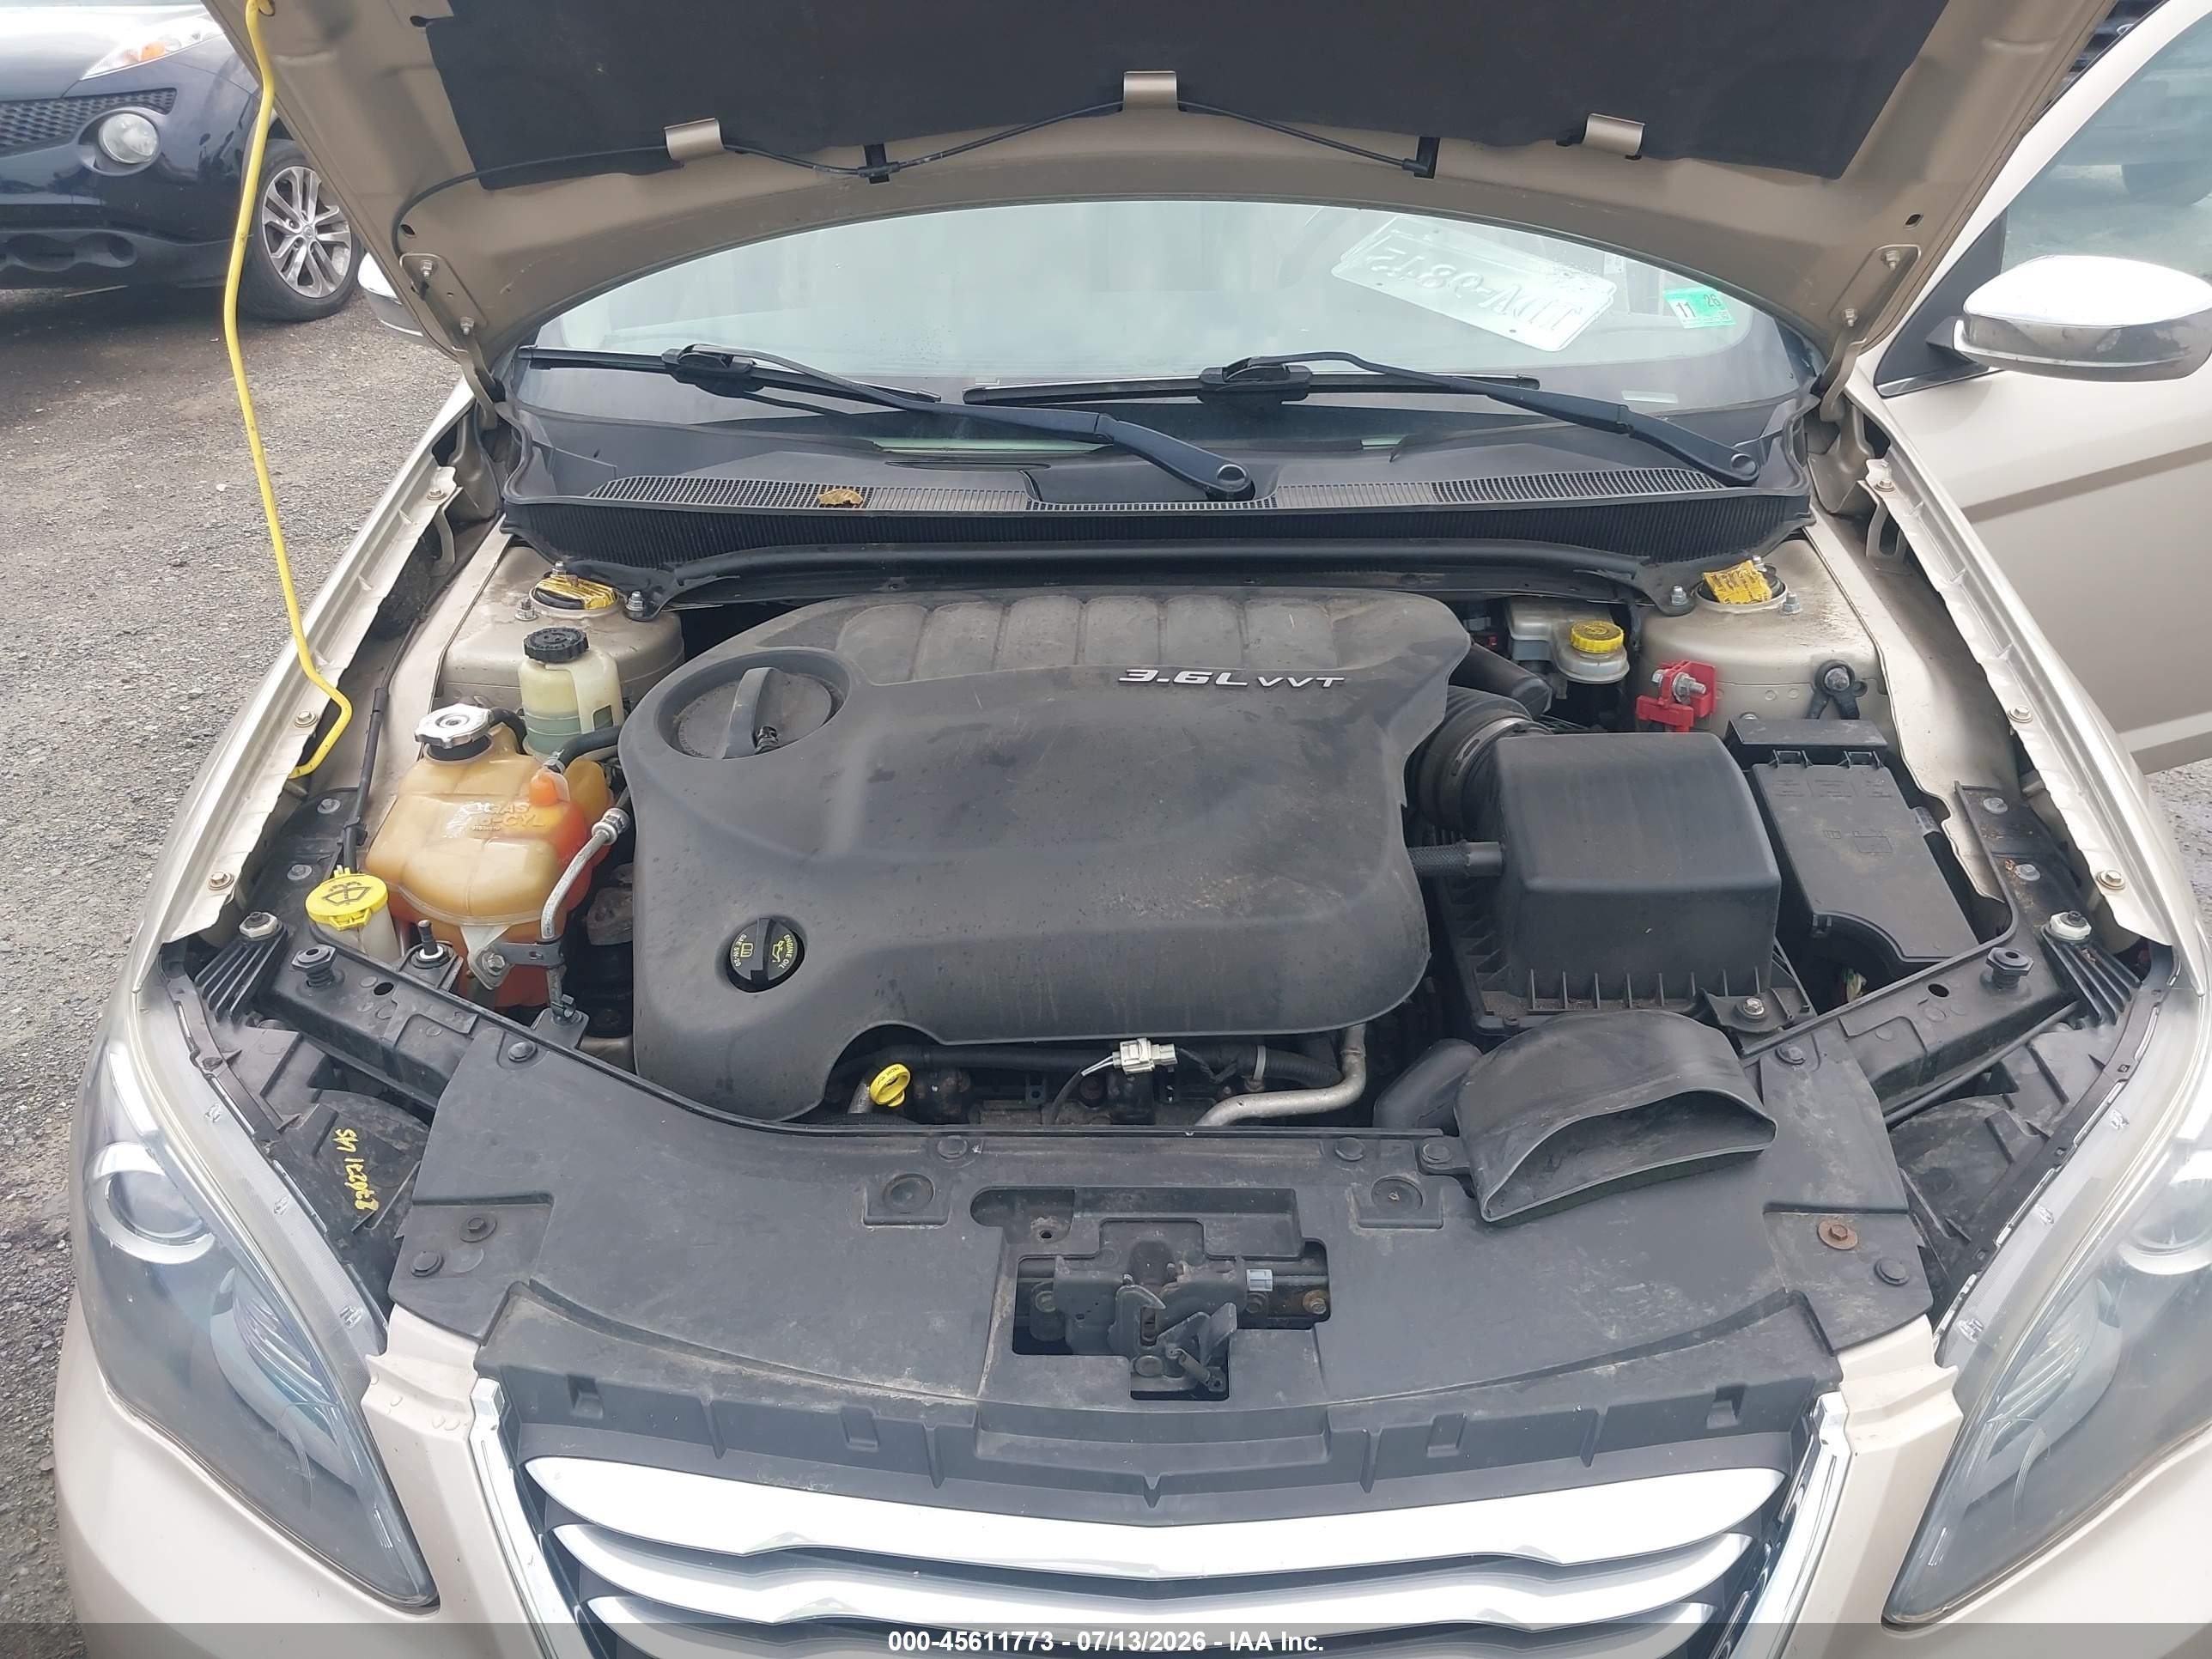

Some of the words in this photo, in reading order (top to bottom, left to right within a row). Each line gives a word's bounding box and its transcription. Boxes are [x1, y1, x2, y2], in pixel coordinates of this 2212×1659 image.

[1703, 293, 1722, 307] 26
[1675, 301, 1696, 318] 11
[1119, 669, 1248, 686] 3.6L
[1257, 677, 1345, 688] VVT
[783, 933, 794, 958] ENGINE
[777, 958, 790, 969] OIL
